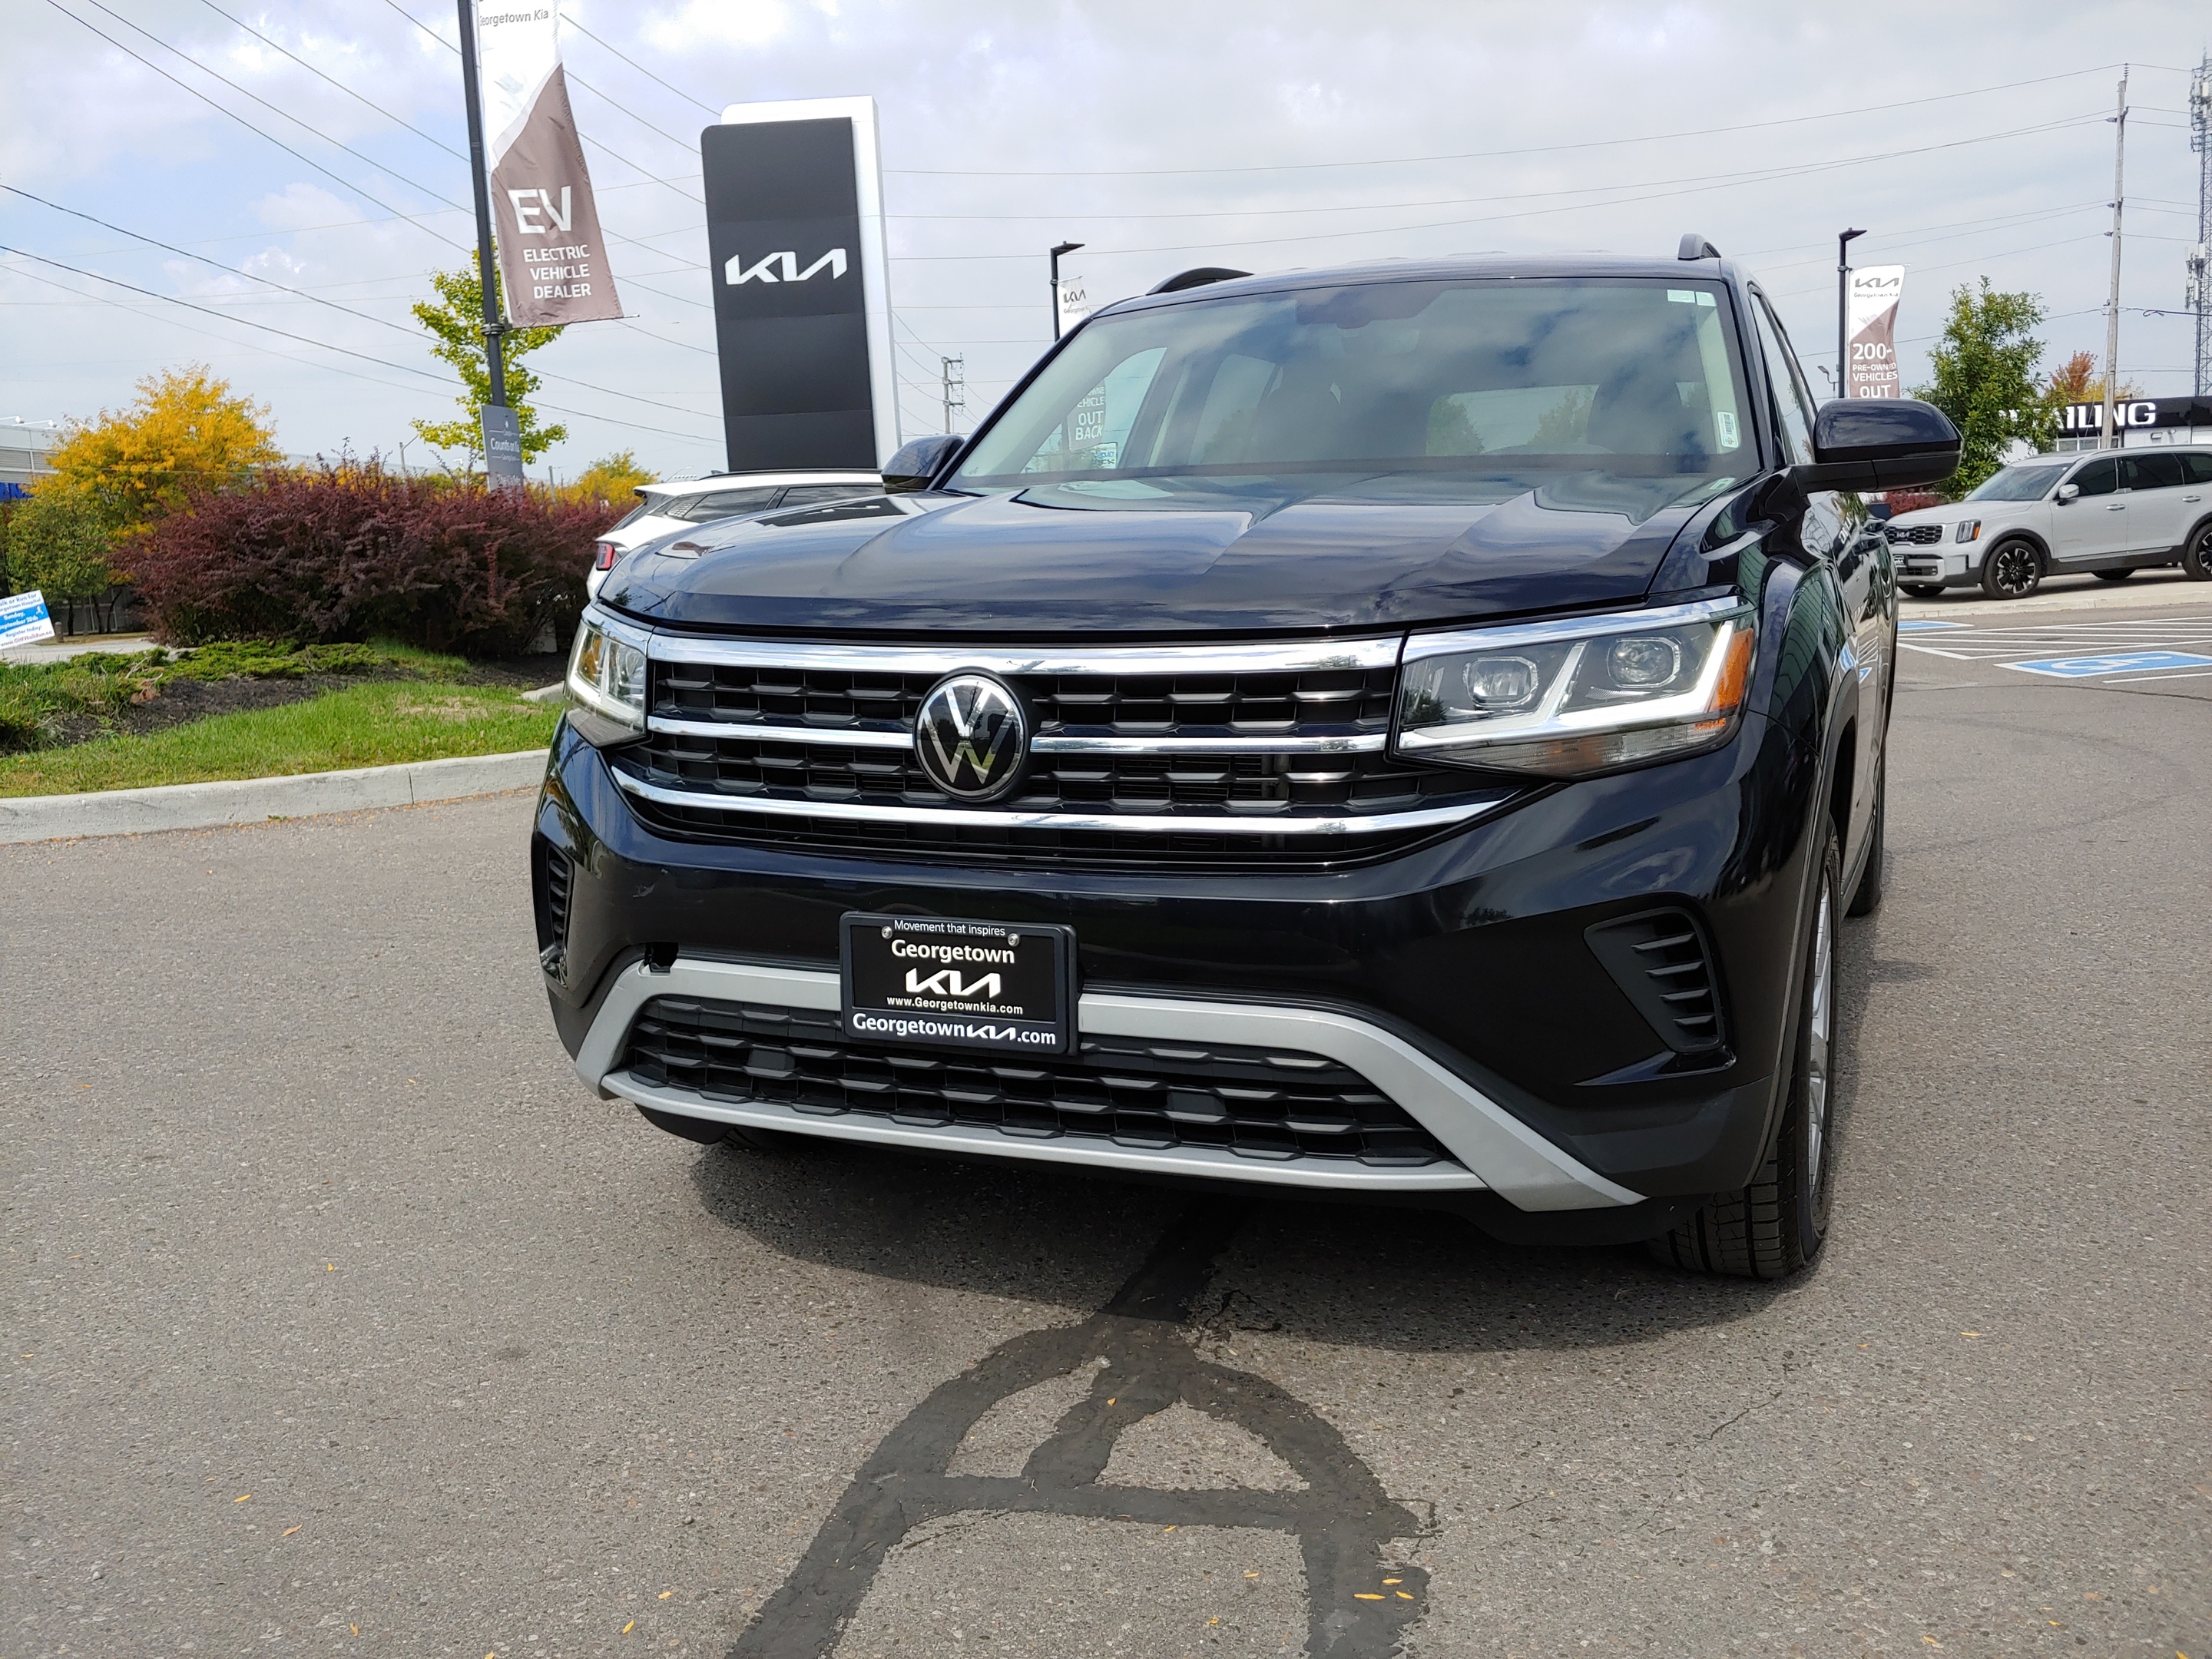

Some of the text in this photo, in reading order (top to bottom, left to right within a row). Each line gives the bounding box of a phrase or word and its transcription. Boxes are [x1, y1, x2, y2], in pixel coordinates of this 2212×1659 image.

[534, 8, 549, 22] Kia
[507, 185, 572, 234] EV
[523, 244, 590, 263] ELECTRIC
[530, 263, 591, 281] VEHICLE
[724, 248, 848, 285] KIA
[1855, 277, 1899, 288] KIA
[533, 283, 592, 300] DEALER
[1852, 363, 1896, 372] PRE-OWNED
[1853, 370, 1898, 382] VEHICLES
[1859, 384, 1892, 398] OUT
[1078, 411, 1104, 426] OUT
[1075, 425, 1104, 441] BACK
[894, 919, 1005, 937] Movement that inspires
[891, 939, 1015, 964] Georgetown
[906, 967, 1001, 998] KIA
[886, 996, 1023, 1015] www.Georgetownkia.com
